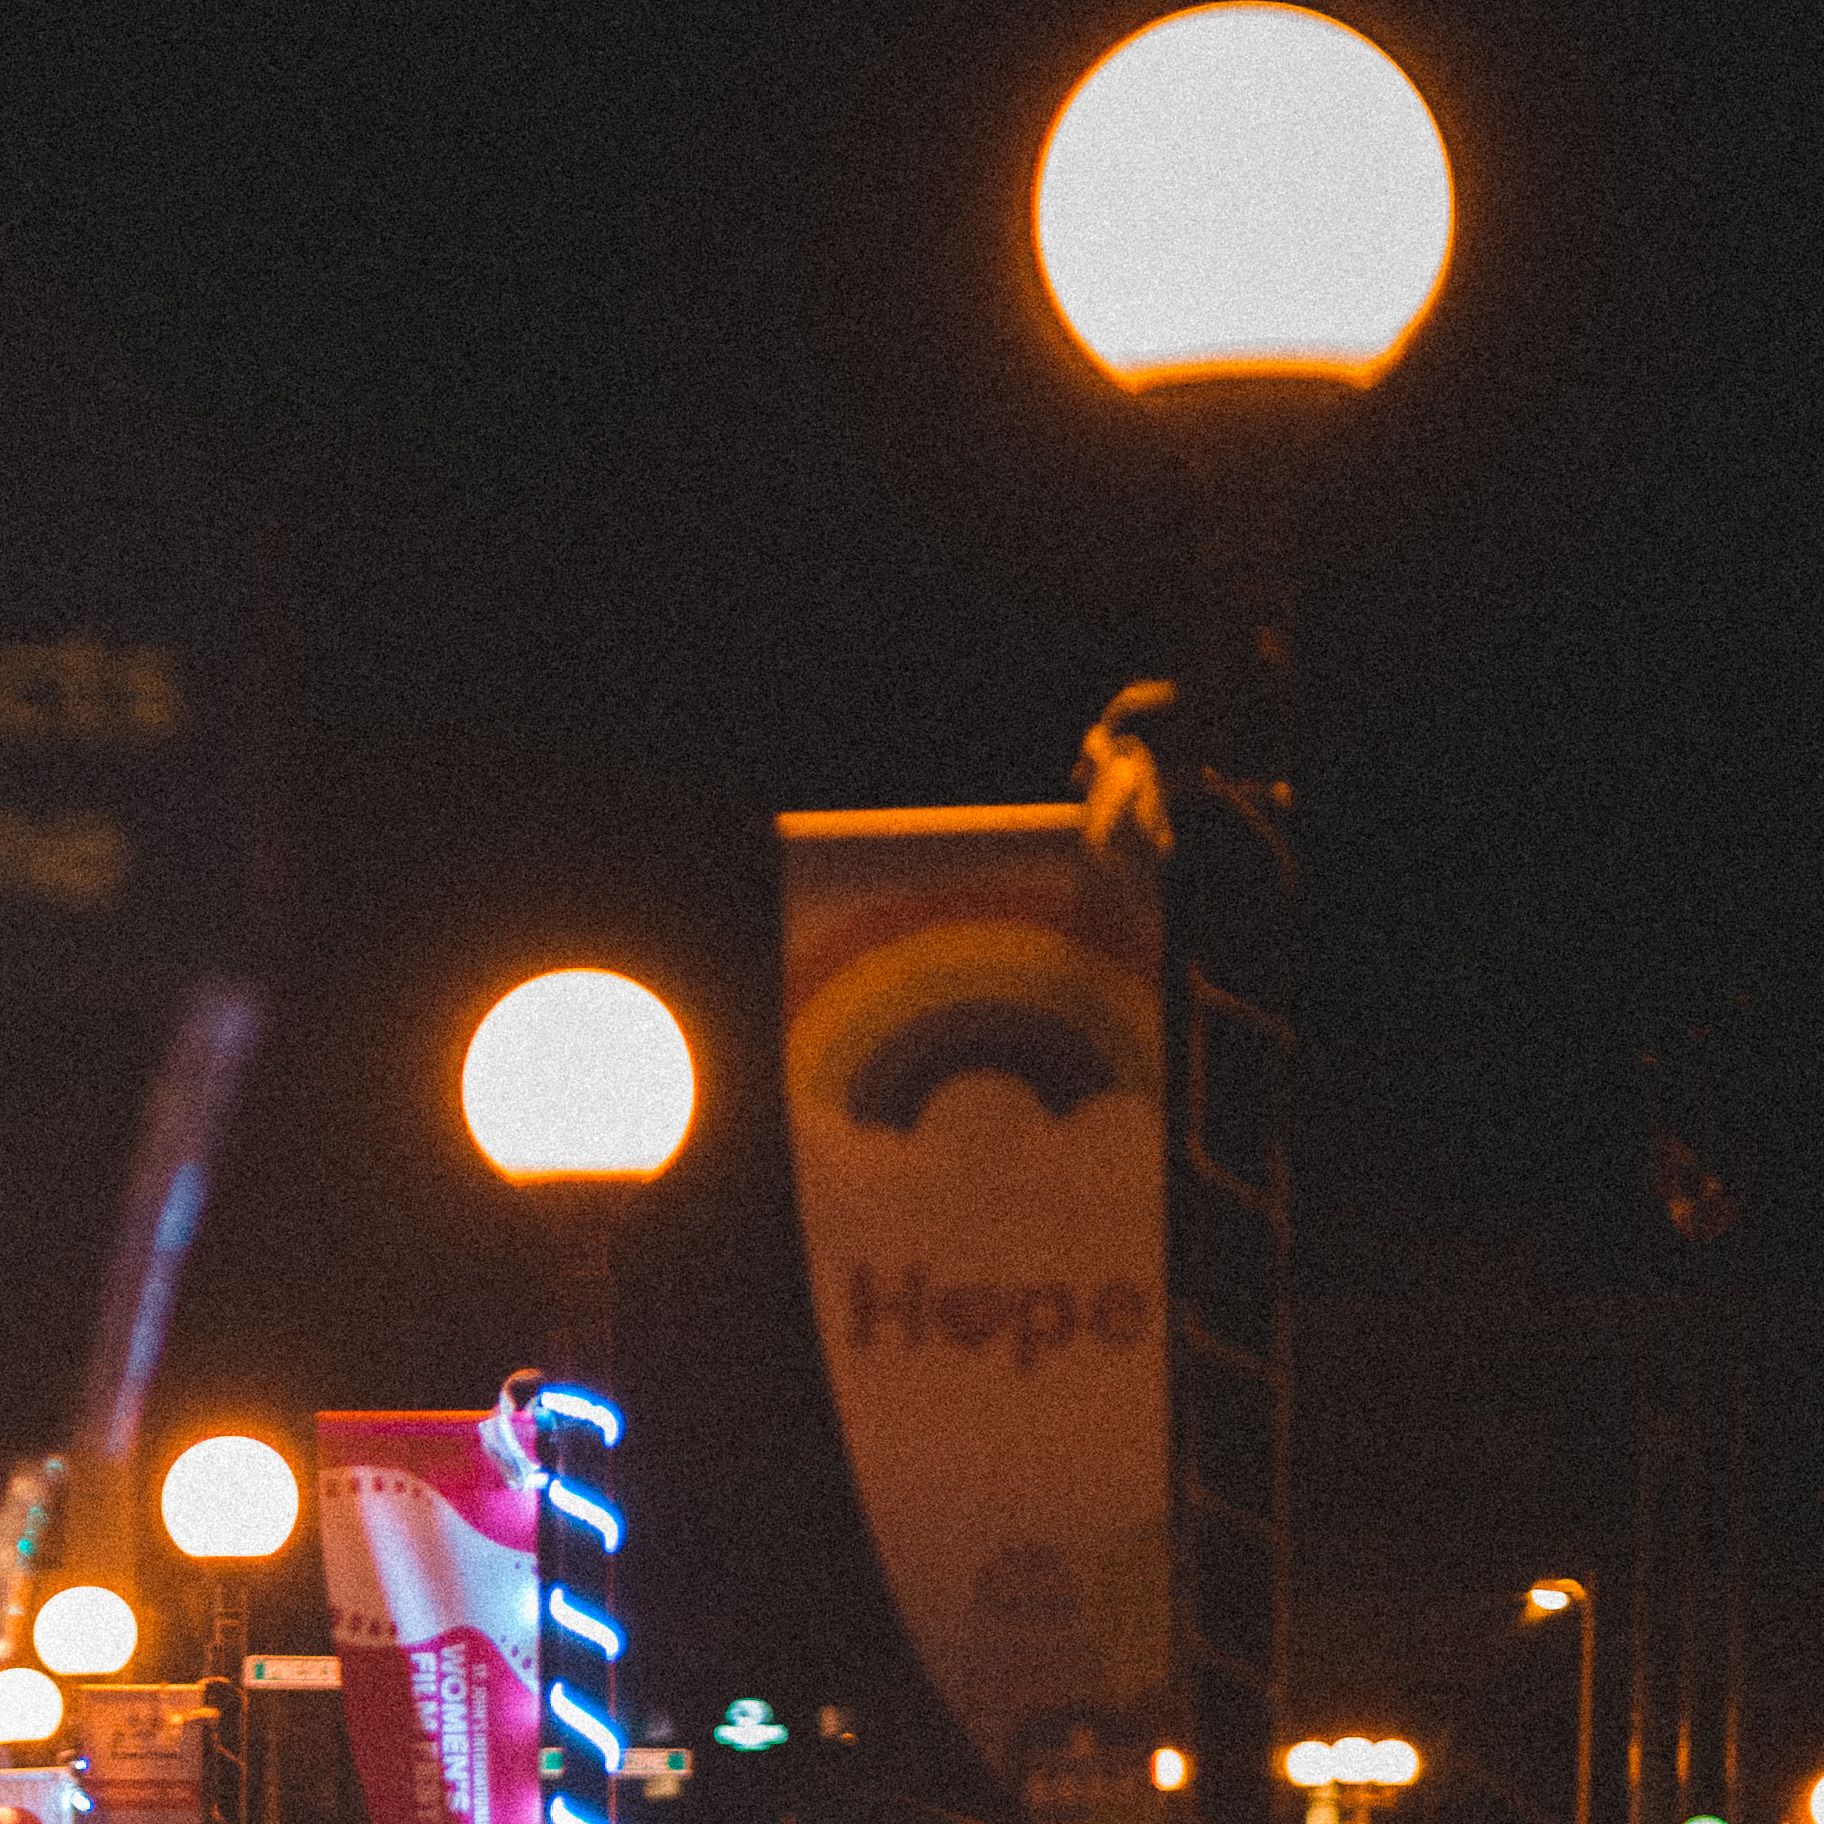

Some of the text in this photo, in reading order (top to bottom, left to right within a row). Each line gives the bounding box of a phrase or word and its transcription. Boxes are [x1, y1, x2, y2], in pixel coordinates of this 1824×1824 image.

[848, 1260, 1146, 1376] Hope
[409, 1652, 439, 1732] FILM
[439, 1642, 470, 1814] WOMEN'S
